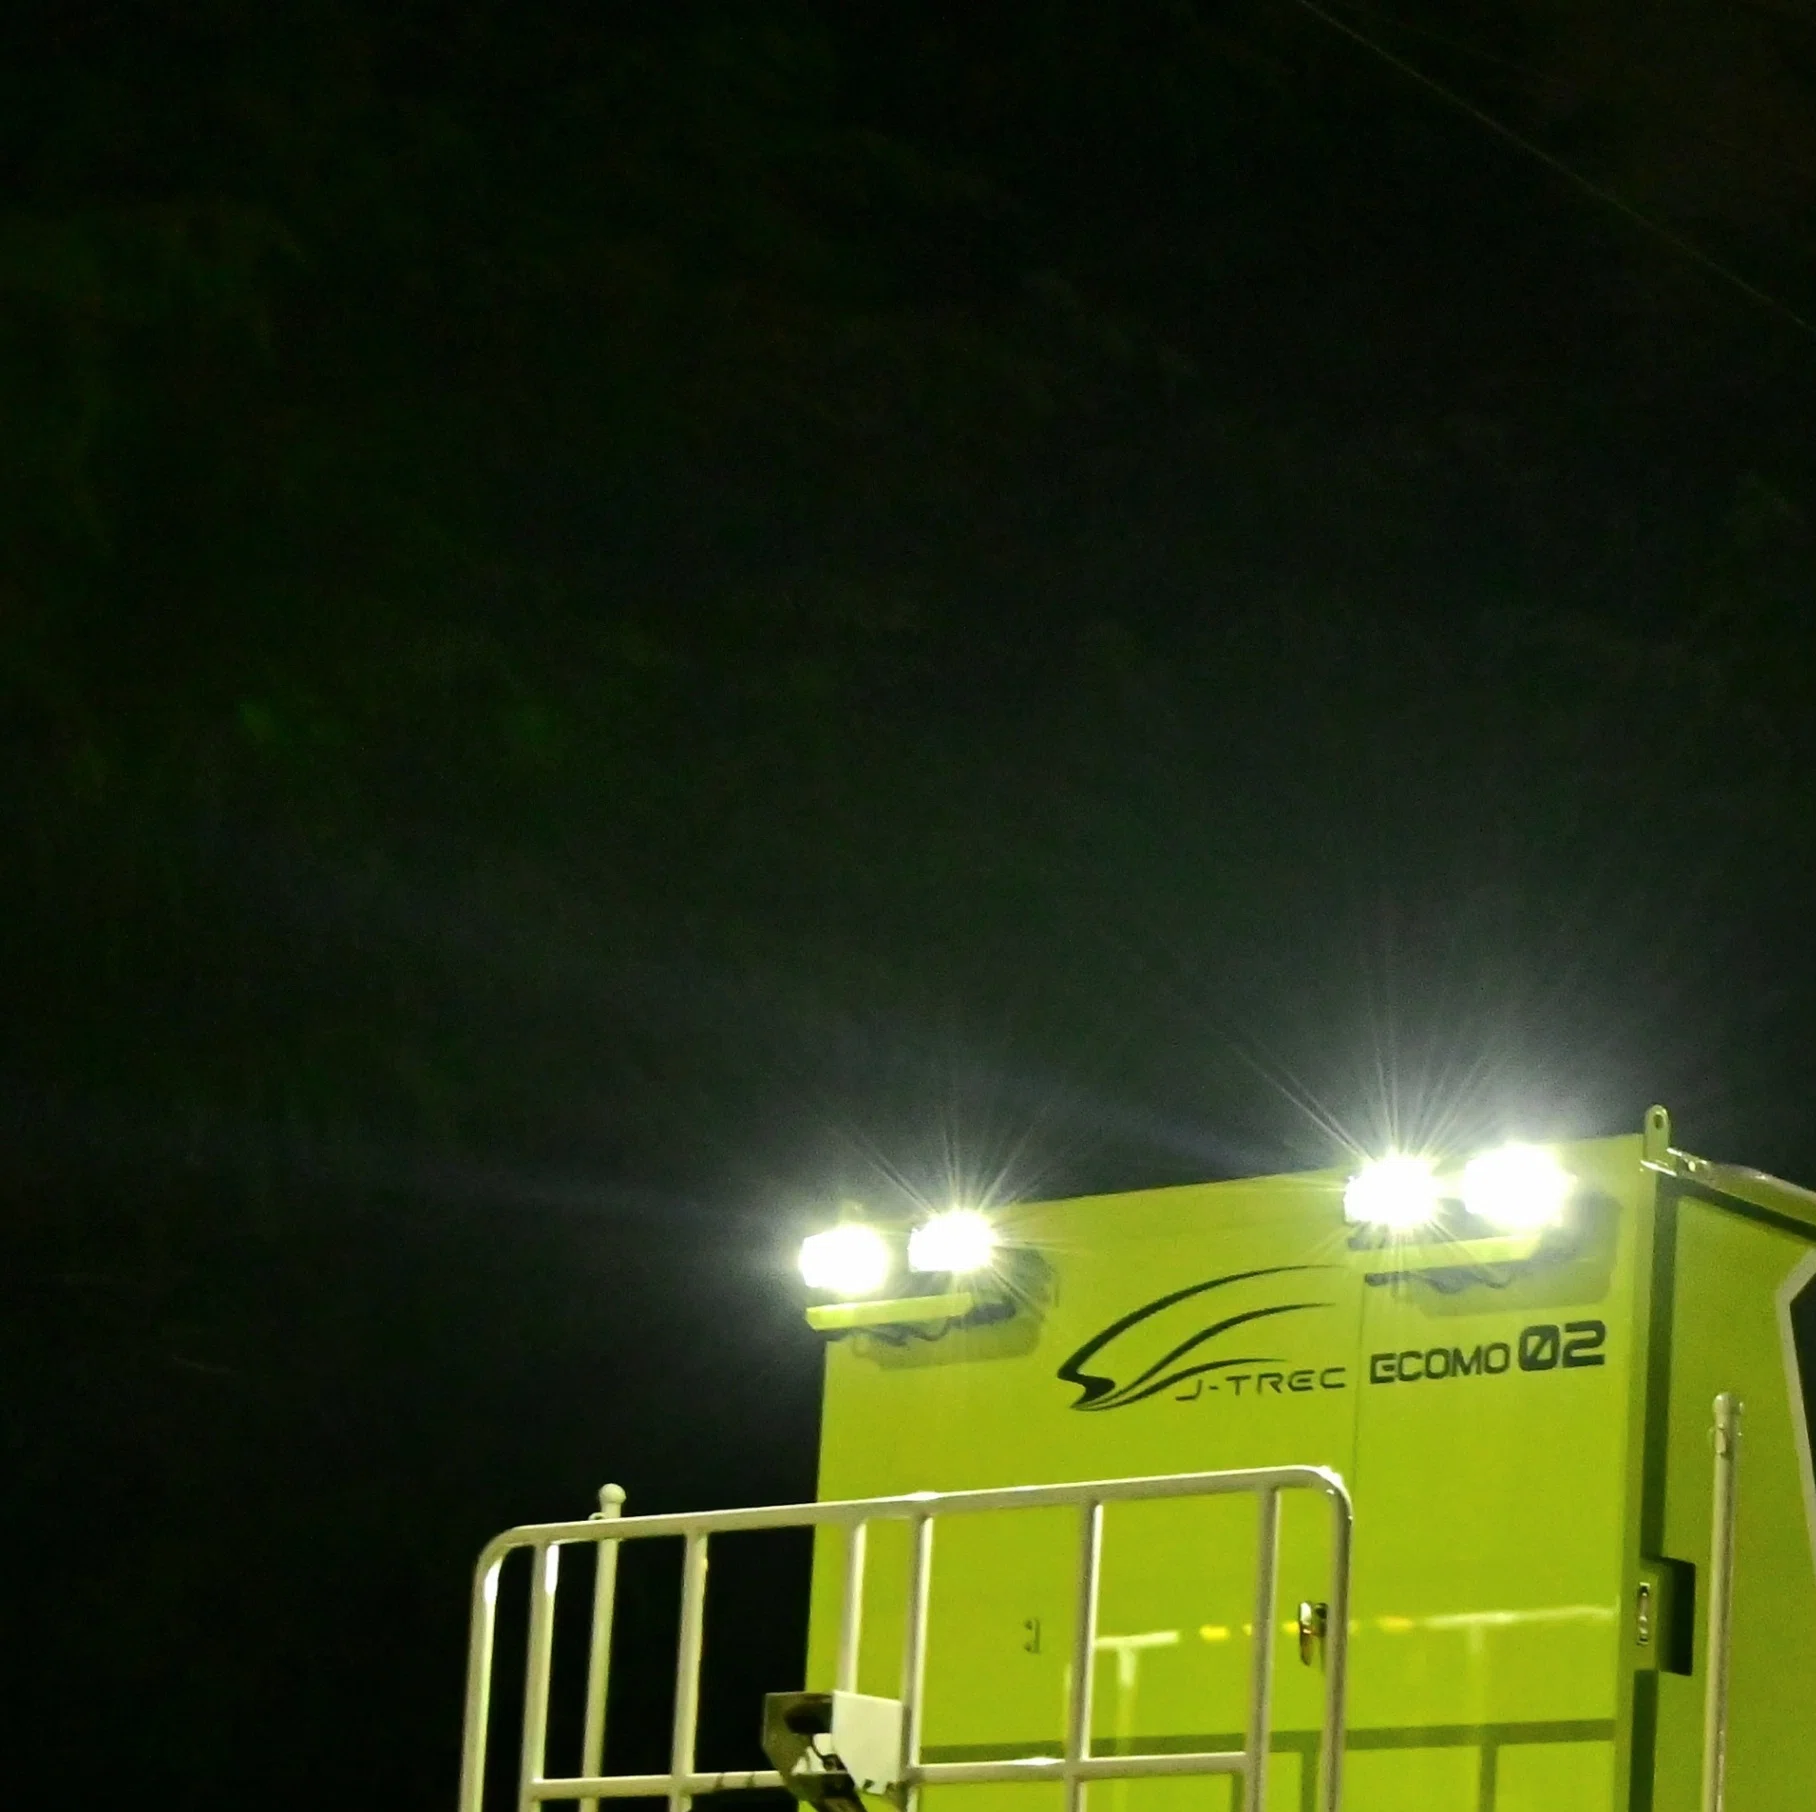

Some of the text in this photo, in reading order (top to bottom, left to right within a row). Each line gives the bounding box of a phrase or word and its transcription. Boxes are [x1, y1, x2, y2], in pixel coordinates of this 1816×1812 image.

[1175, 1320, 1607, 1401] J-TREC ECOMO 02
